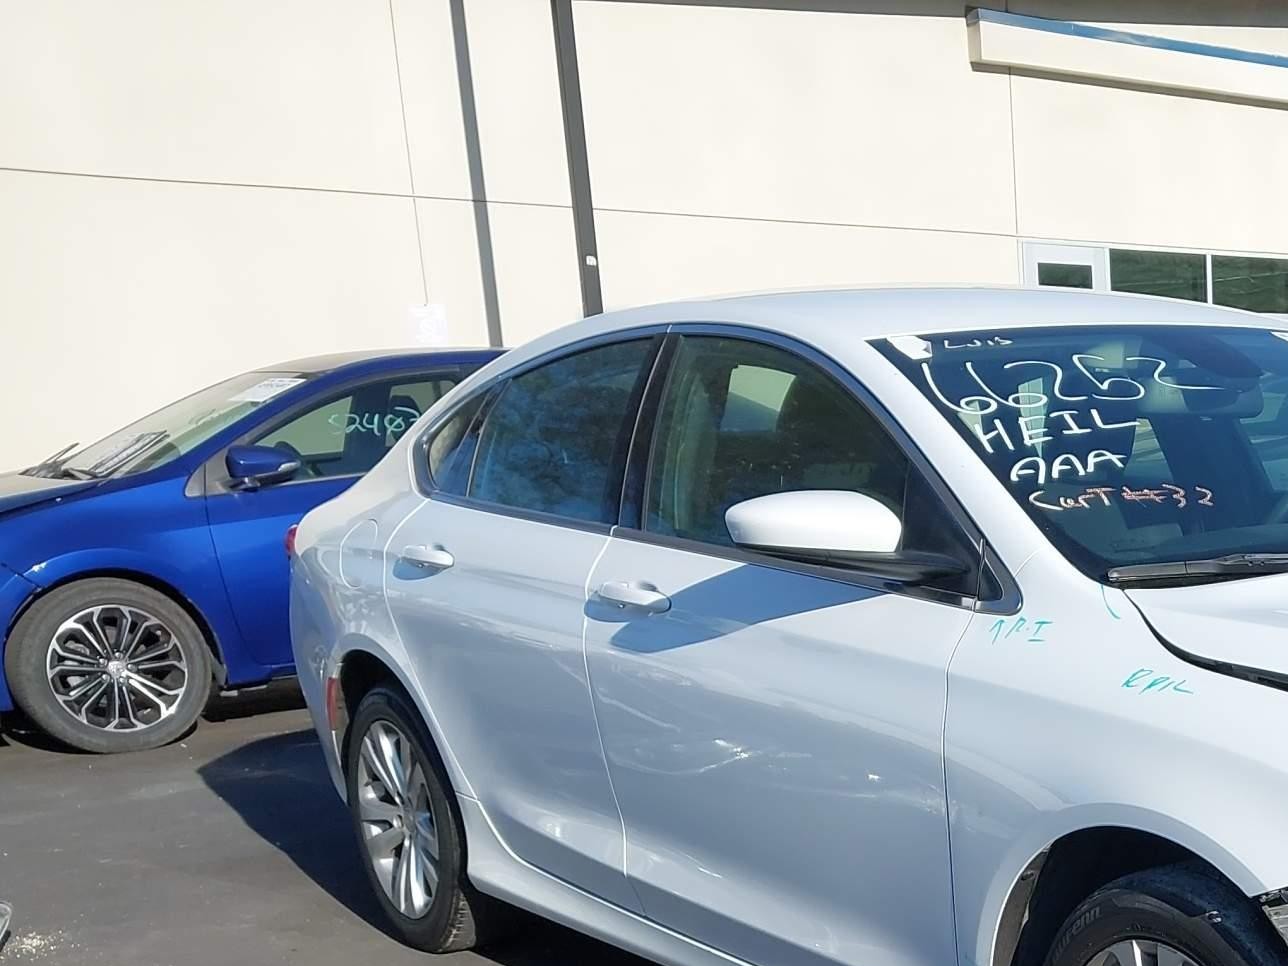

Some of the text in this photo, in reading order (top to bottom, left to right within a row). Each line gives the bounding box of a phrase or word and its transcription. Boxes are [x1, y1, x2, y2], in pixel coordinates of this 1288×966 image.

[920, 352, 1226, 414] 66252
[973, 407, 1141, 453] HEIL
[1009, 449, 1128, 484] AAA
